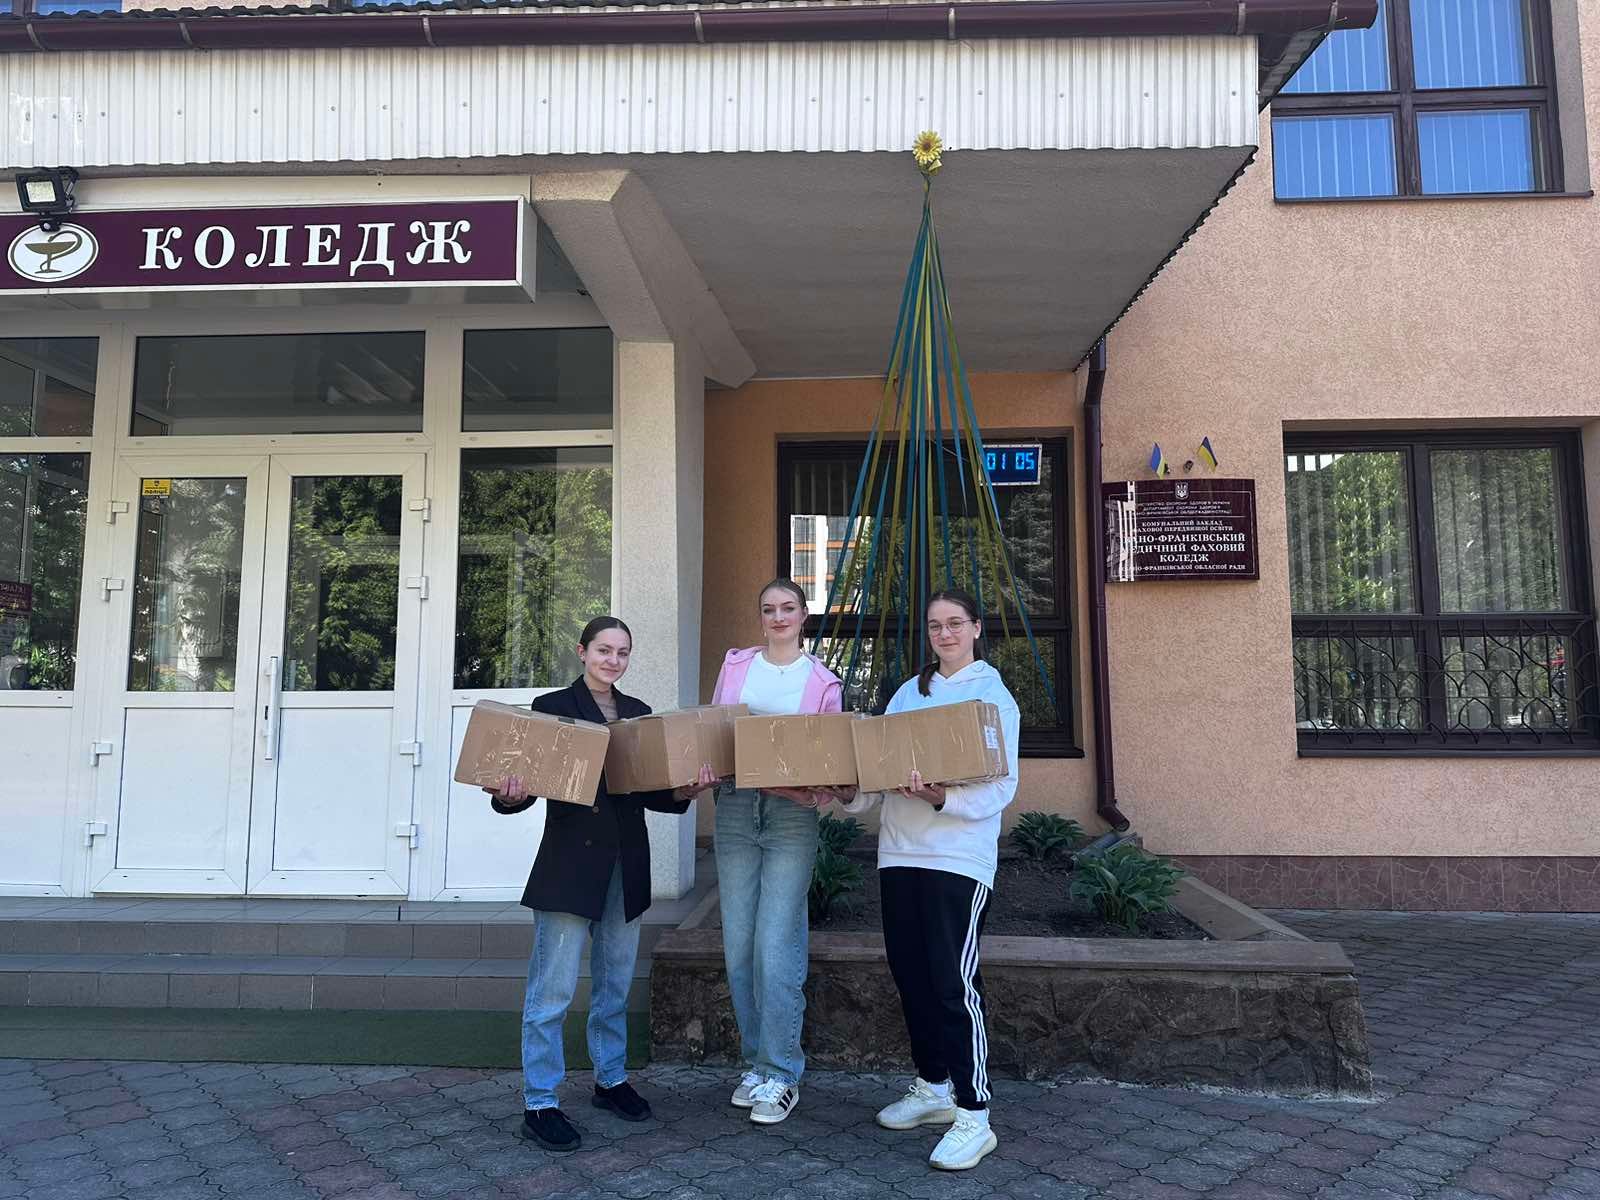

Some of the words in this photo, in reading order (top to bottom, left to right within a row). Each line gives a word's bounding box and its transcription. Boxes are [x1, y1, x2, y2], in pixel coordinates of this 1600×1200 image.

[138, 220, 473, 277] КОЛЕДЖ
[1142, 519, 1195, 527] КОМУНАЛЬНИЙ
[1132, 543, 1187, 553] ЕДИЧНИЙ
[1190, 543, 1246, 552] ФАХОВИЙ
[1159, 553, 1209, 563] КОЛЕДЖ
